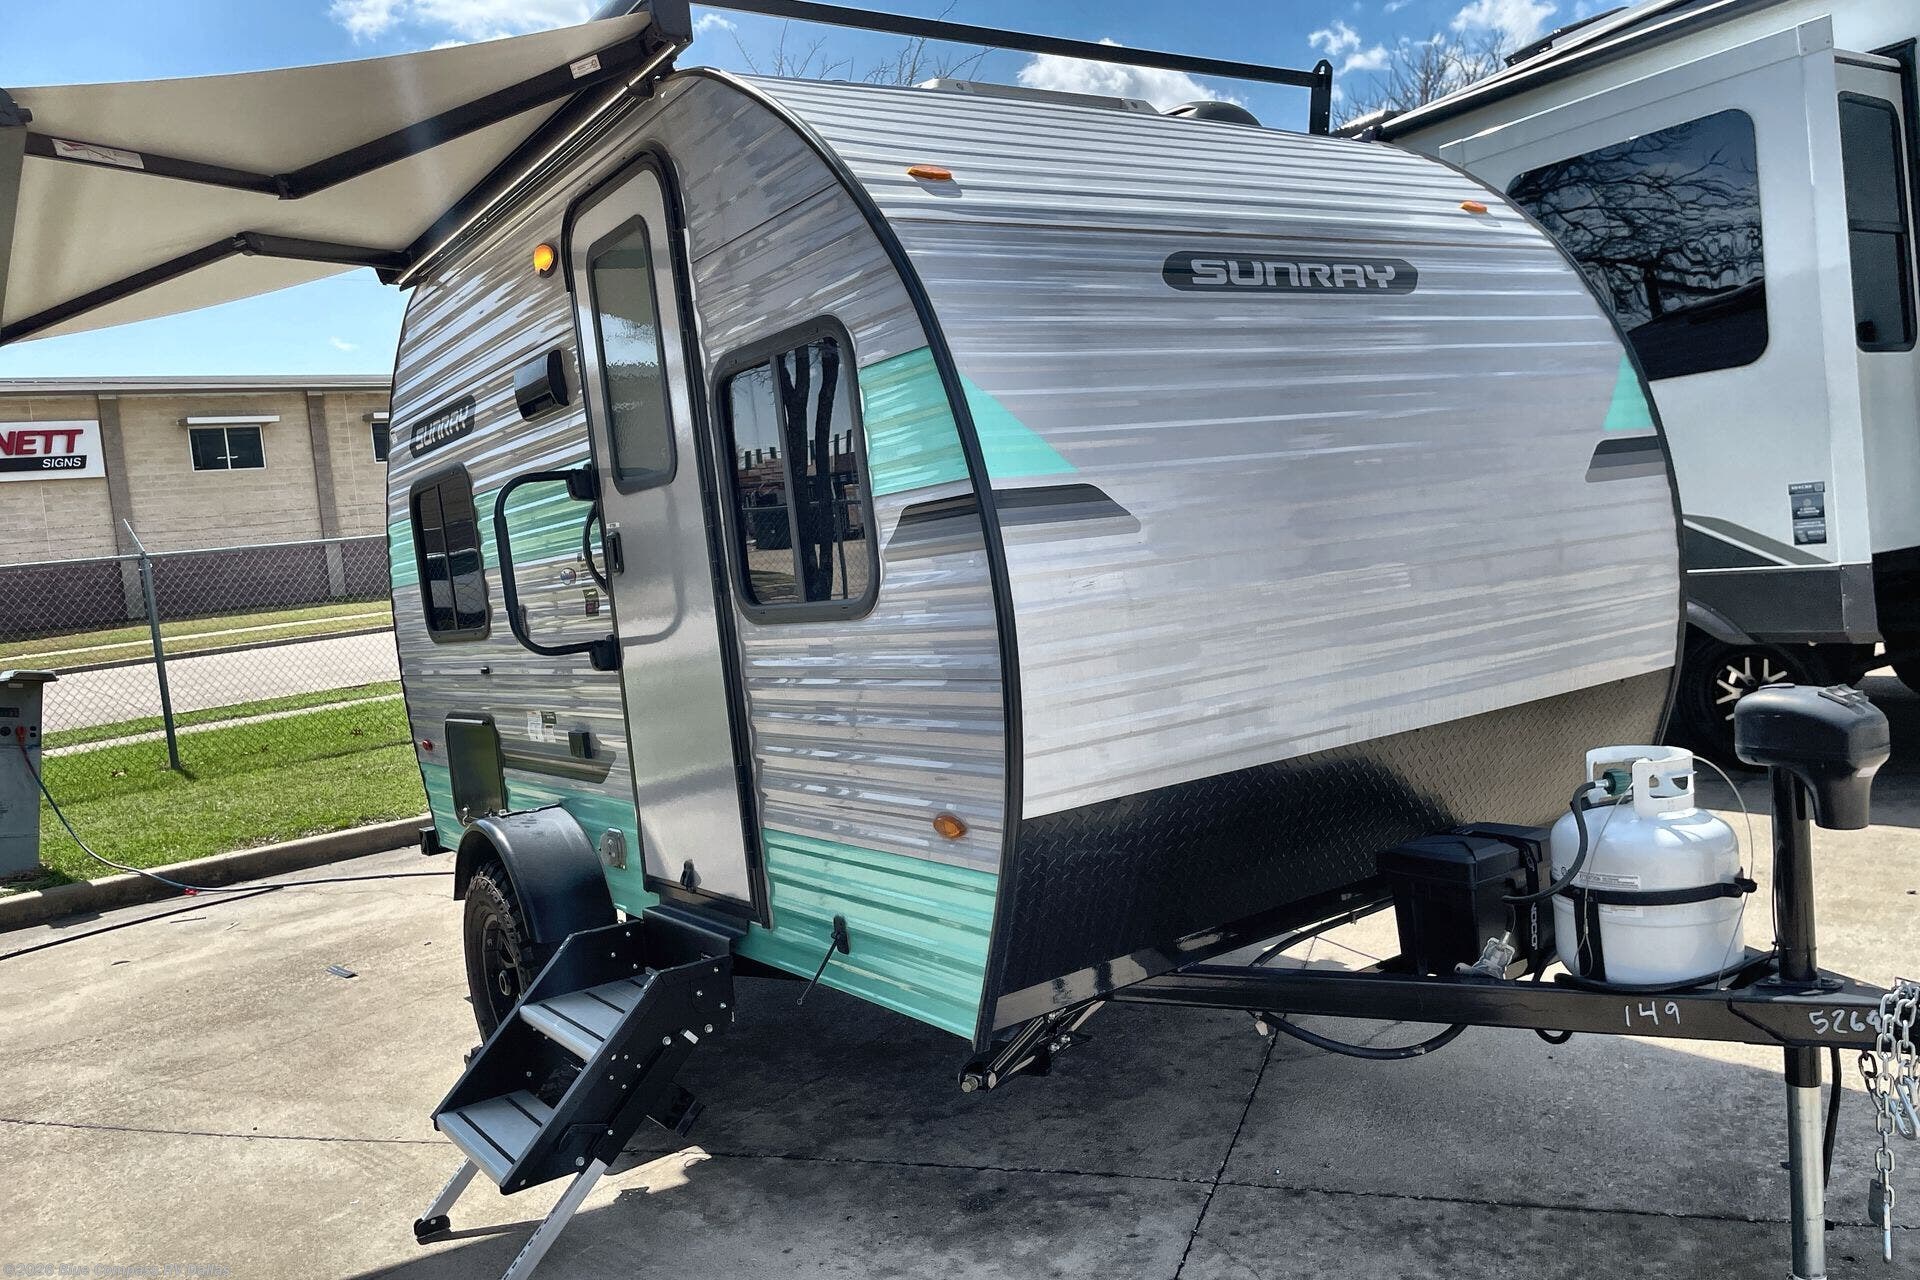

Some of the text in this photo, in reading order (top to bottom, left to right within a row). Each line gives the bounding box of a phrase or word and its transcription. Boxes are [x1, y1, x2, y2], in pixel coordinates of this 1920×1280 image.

[1191, 259, 1396, 288] SUNRAY
[415, 405, 471, 451] SUNRAY
[42, 457, 82, 468] SIGNS
[1625, 1000, 1680, 1027] 149
